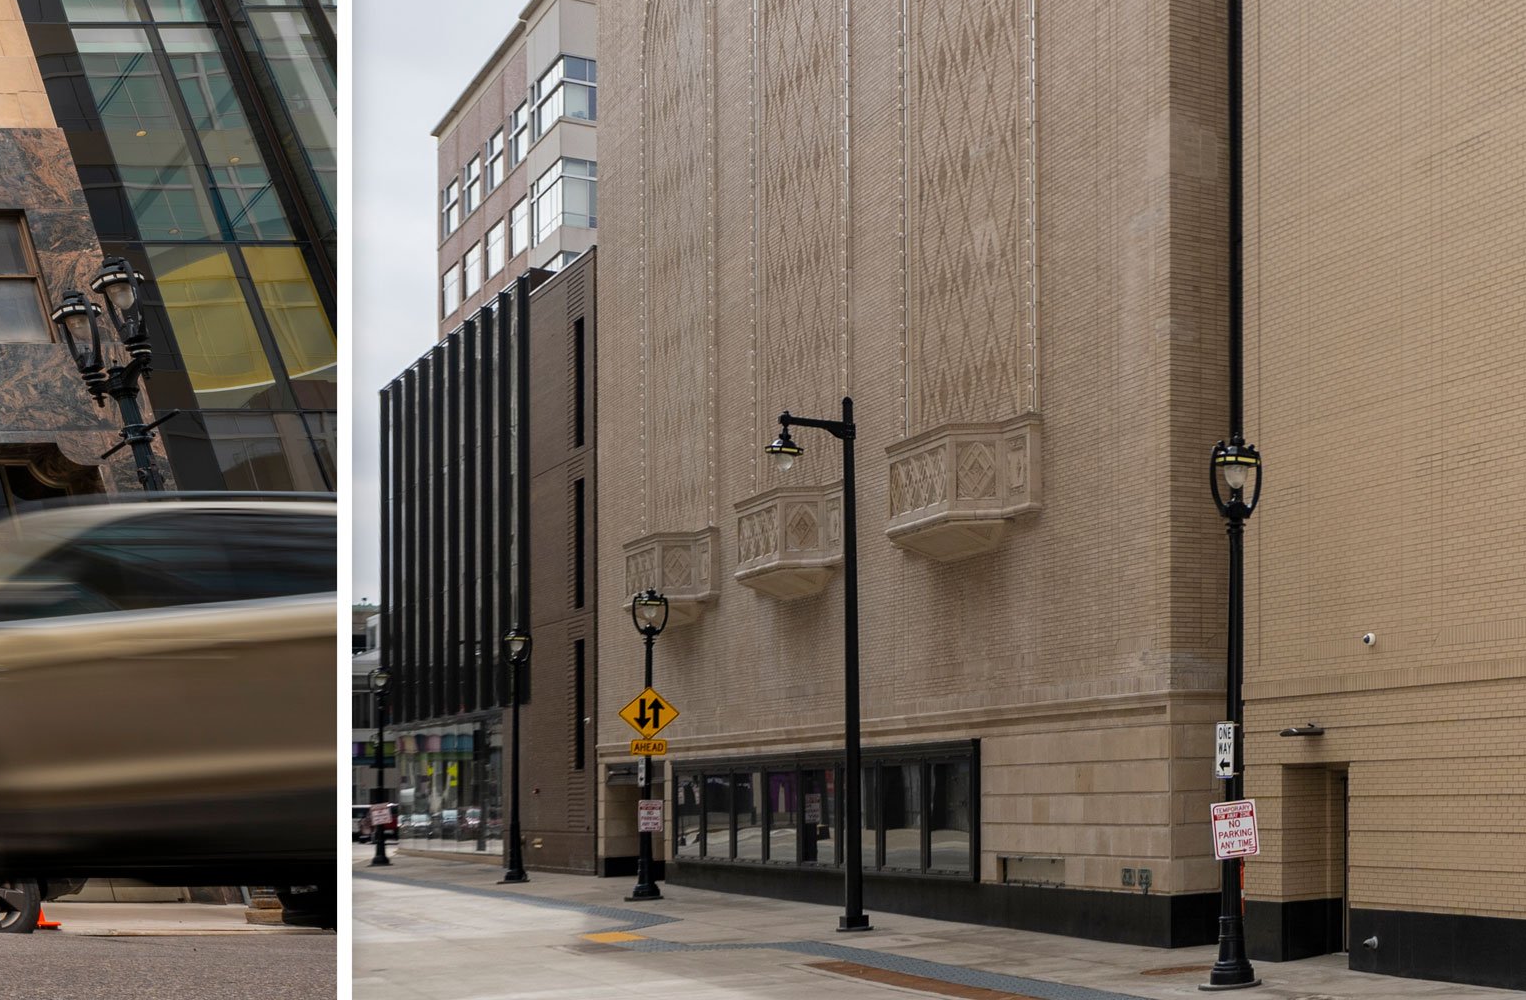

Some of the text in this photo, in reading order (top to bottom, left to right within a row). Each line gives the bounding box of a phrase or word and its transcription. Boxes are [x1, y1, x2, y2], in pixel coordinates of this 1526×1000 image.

[1218, 726, 1232, 740] ONE
[634, 742, 664, 752] AHEAD
[1218, 742, 1232, 755] WAY
[1216, 804, 1250, 814] TEMPORARY
[1228, 819, 1241, 828] NO
[1218, 828, 1253, 839] PARKING
[1220, 838, 1254, 850] ANY TIME
